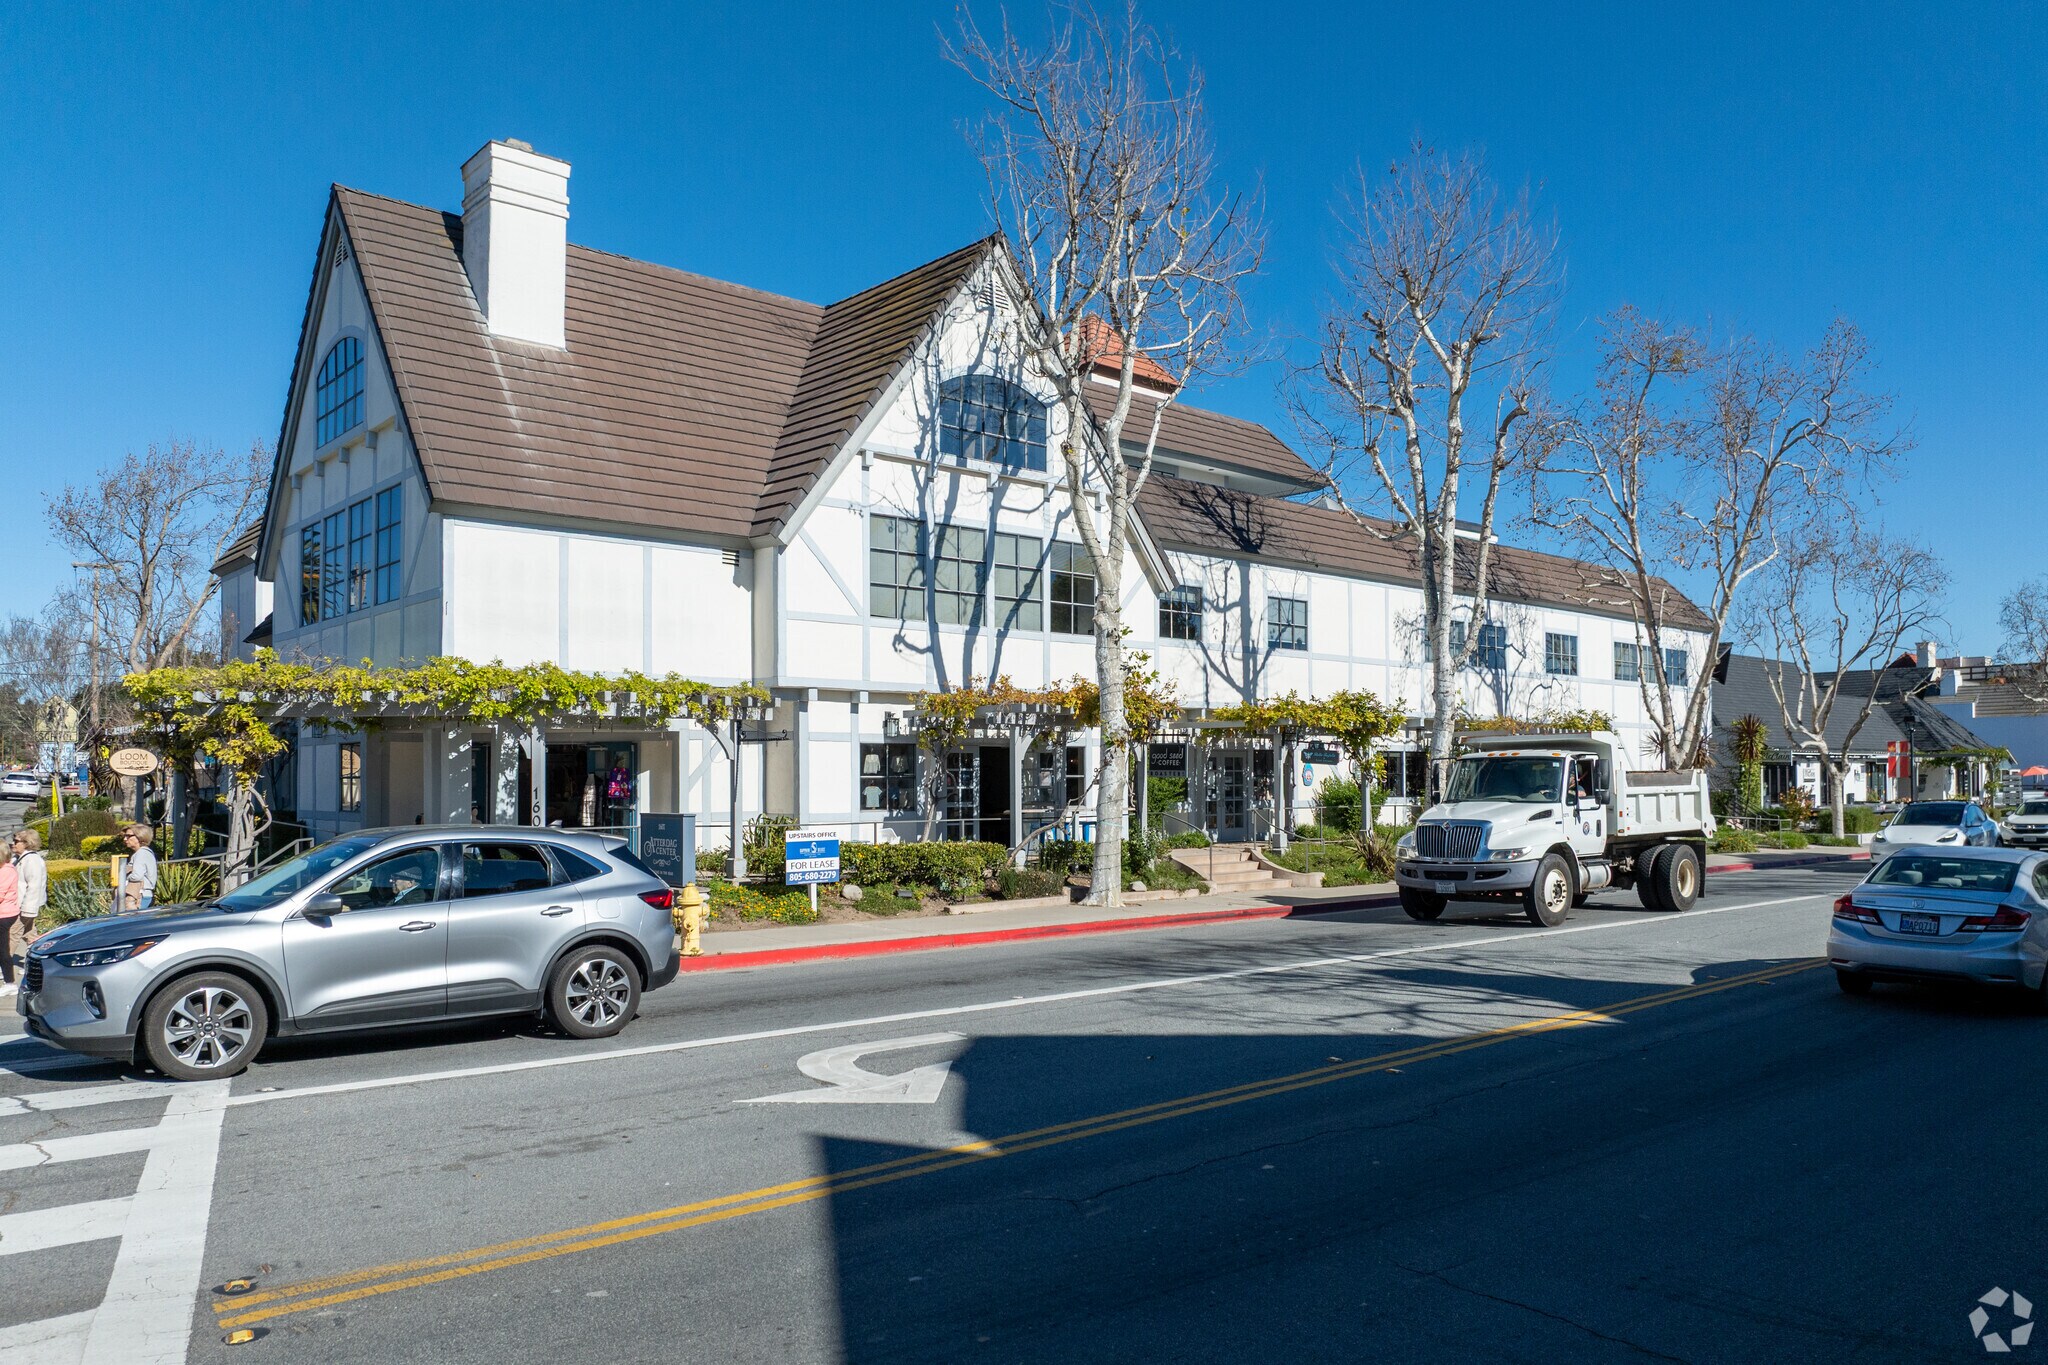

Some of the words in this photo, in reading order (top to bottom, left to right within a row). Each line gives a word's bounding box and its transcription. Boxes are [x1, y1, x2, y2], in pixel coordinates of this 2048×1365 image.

[120, 753, 148, 761] LOOM
[1151, 748, 1168, 765] good
[1169, 748, 1184, 759] seed
[533, 787, 541, 826] 160
[656, 847, 679, 858] CENTER
[791, 862, 807, 870] FOR
[810, 860, 834, 868] LEASE
[789, 871, 837, 882] 805-680-2279
